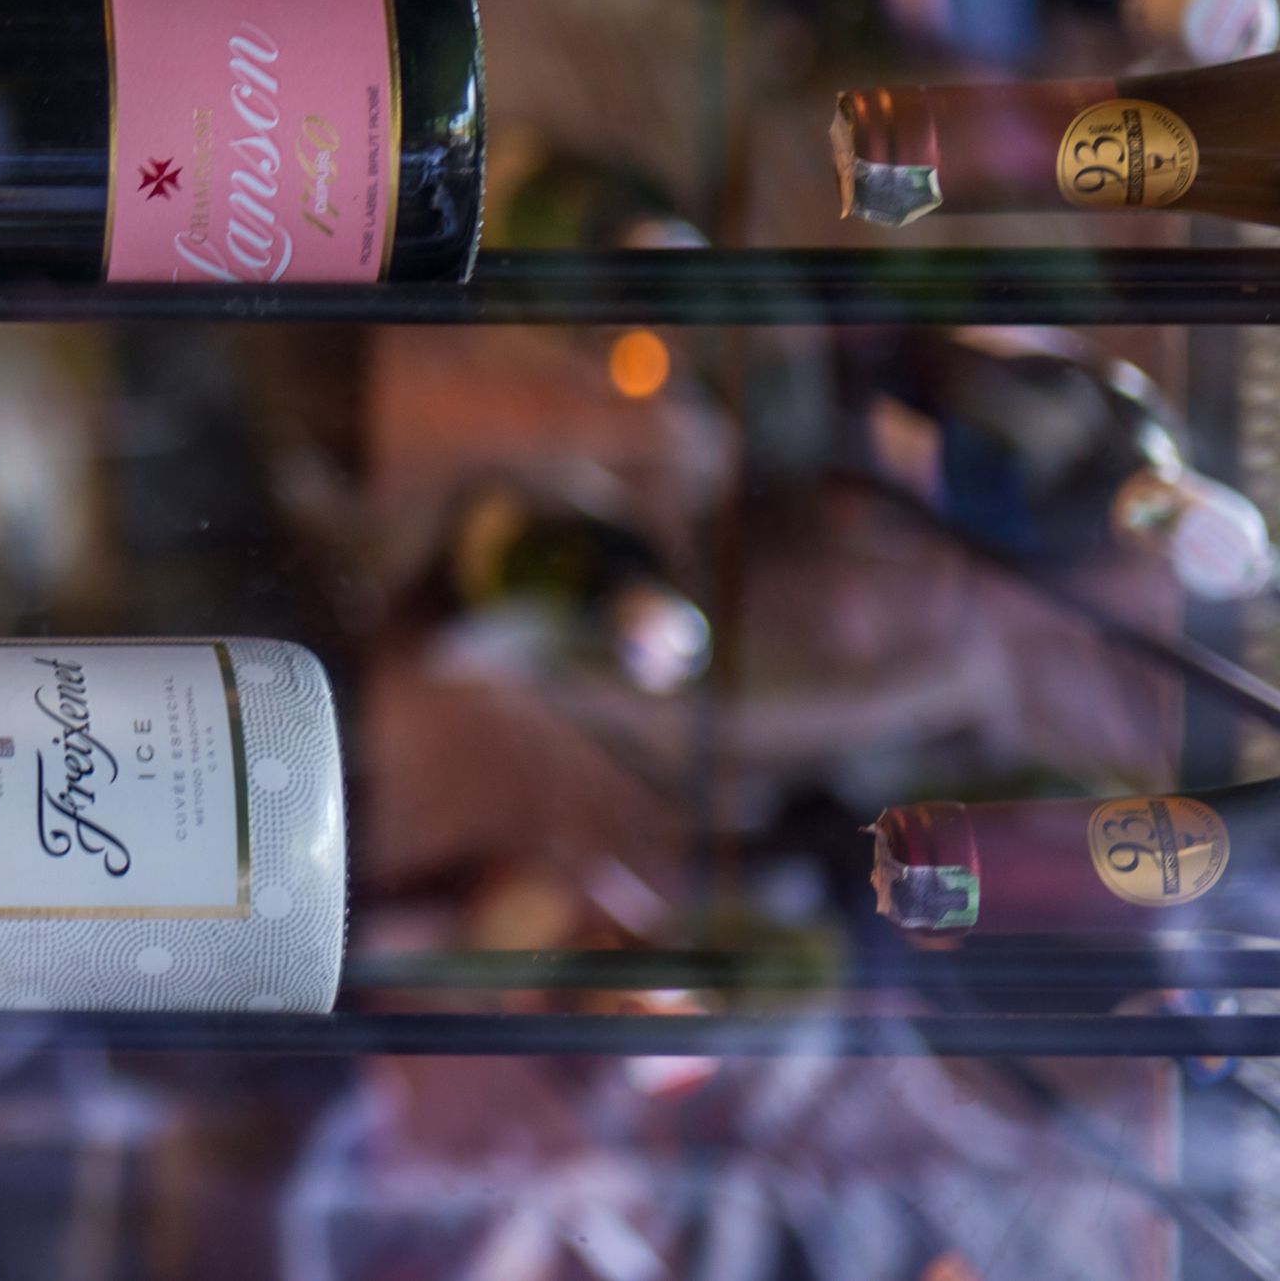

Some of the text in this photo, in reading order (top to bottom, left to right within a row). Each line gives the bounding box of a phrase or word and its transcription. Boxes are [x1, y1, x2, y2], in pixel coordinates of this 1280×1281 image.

[292, 114, 341, 238] 1760
[1072, 134, 1126, 195] 93
[163, 674, 184, 759] ESPECIAL
[204, 725, 218, 773] CAVA
[31, 656, 132, 880] Freixenet
[133, 717, 157, 782] ICE
[1102, 816, 1162, 873] 93
